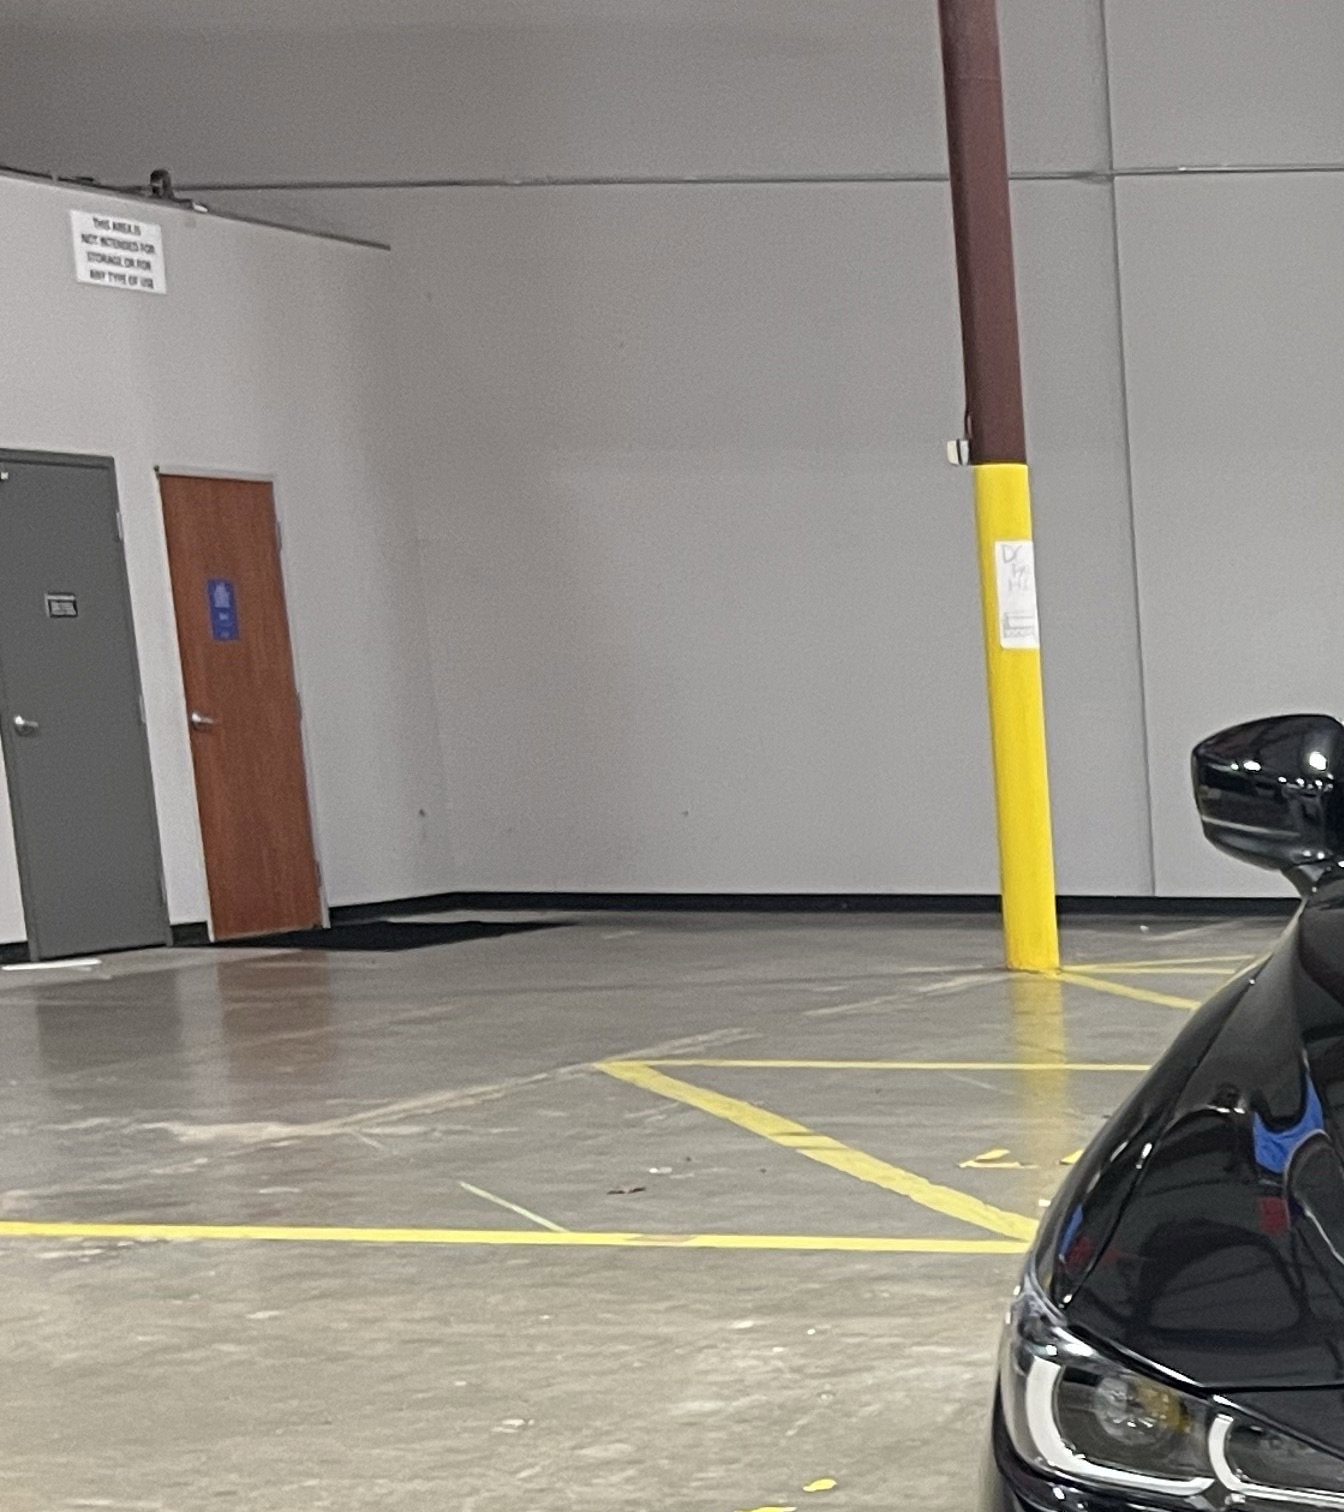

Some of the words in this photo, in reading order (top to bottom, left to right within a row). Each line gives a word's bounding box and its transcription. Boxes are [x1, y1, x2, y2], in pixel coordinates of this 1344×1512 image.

[92, 217, 111, 231] THIS
[112, 221, 132, 234] AREA
[81, 233, 99, 245] NOT
[100, 236, 139, 252] INTENDED
[140, 242, 156, 255] FOR
[86, 251, 122, 267] STORAGE
[136, 259, 152, 271] FOR
[90, 269, 106, 281] ANY
[107, 271, 127, 285] TYPE
[140, 277, 154, 289] USE
